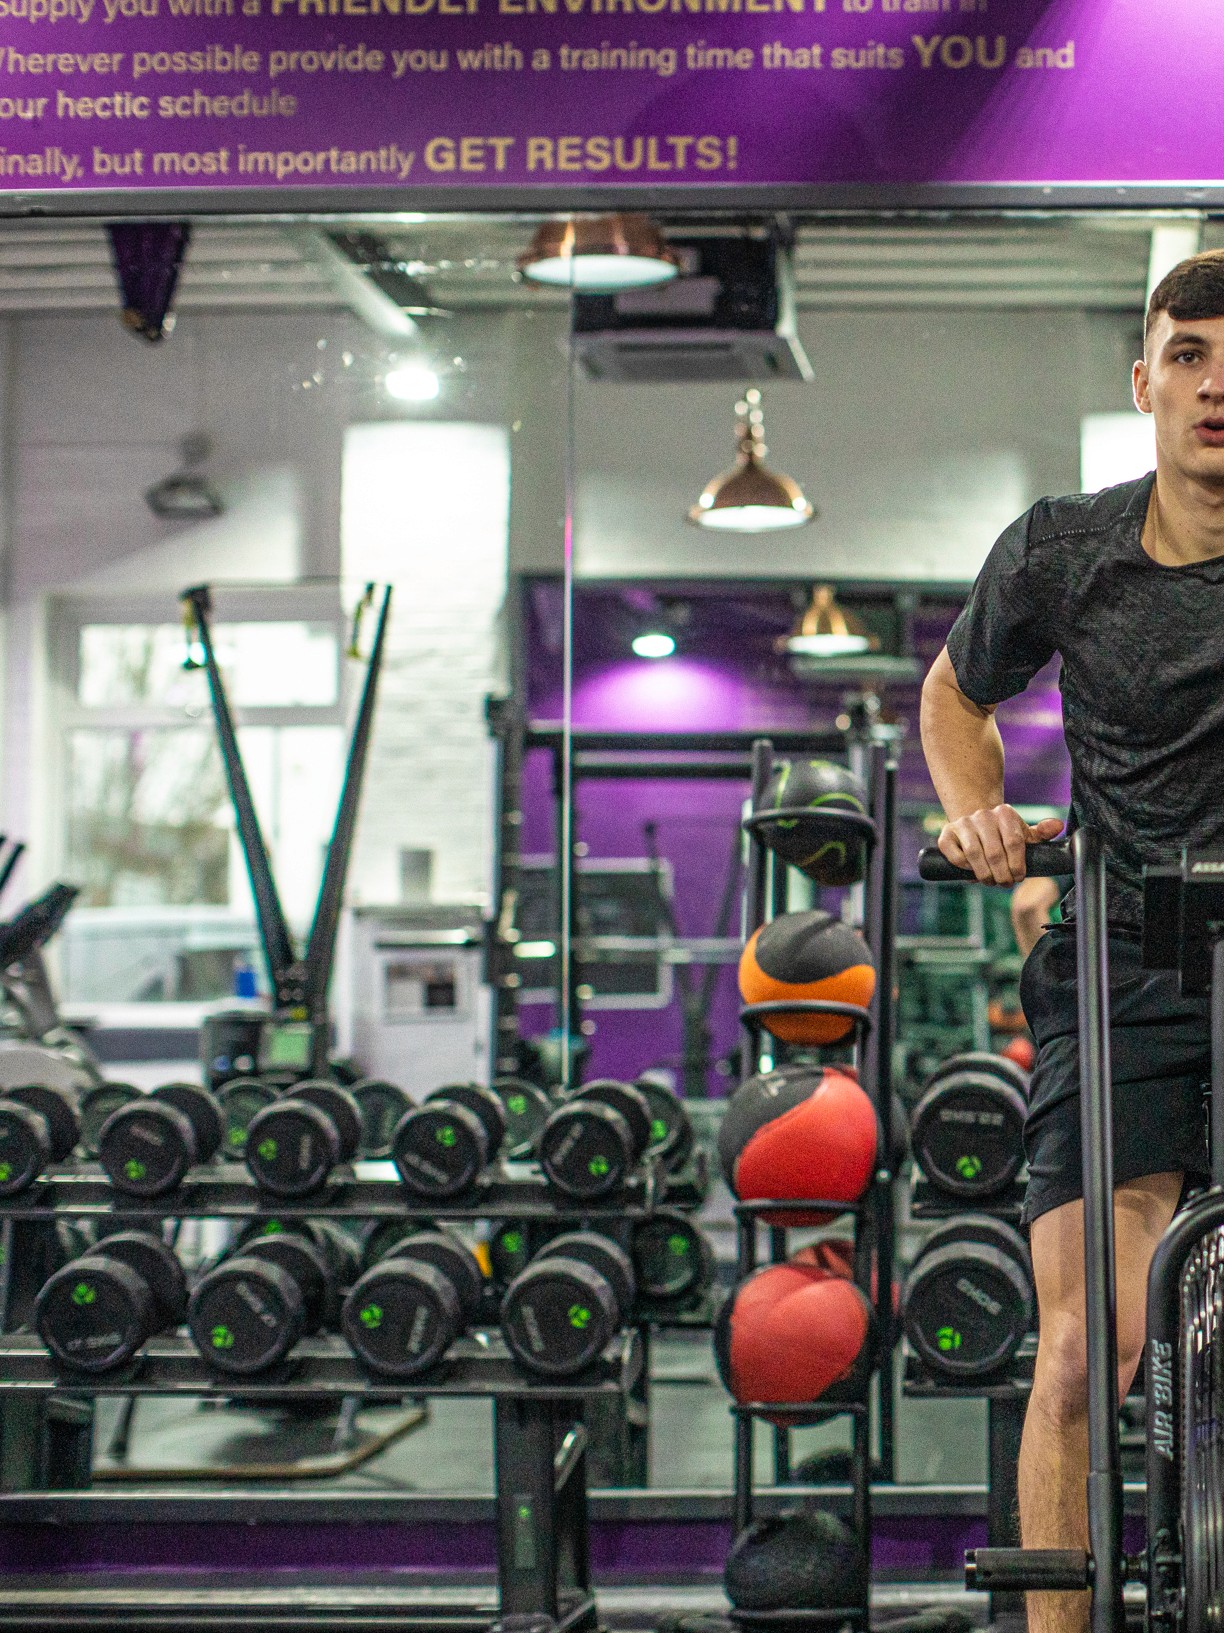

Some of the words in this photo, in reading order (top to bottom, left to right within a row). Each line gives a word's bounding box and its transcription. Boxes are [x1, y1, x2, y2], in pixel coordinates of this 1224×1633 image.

[103, 0, 159, 24] you
[0, 45, 124, 75] herever
[132, 44, 261, 80] possible
[268, 43, 386, 79] provide
[391, 49, 449, 79] you
[456, 42, 524, 72] with
[531, 48, 551, 72] a
[558, 41, 679, 77] training
[685, 40, 755, 70] time
[761, 40, 823, 70] that
[830, 40, 903, 70] suits
[910, 34, 1007, 69] YOU
[1016, 40, 1077, 70] and
[56, 90, 150, 119] hectic
[157, 88, 297, 119] schedule
[92, 146, 144, 176] but
[152, 147, 231, 175] most
[238, 144, 415, 180] importantly
[423, 137, 515, 172] GET
[525, 136, 738, 172] RESULTS!
[1151, 1339, 1173, 1406] BIKE
[1153, 1410, 1174, 1462] AIR
